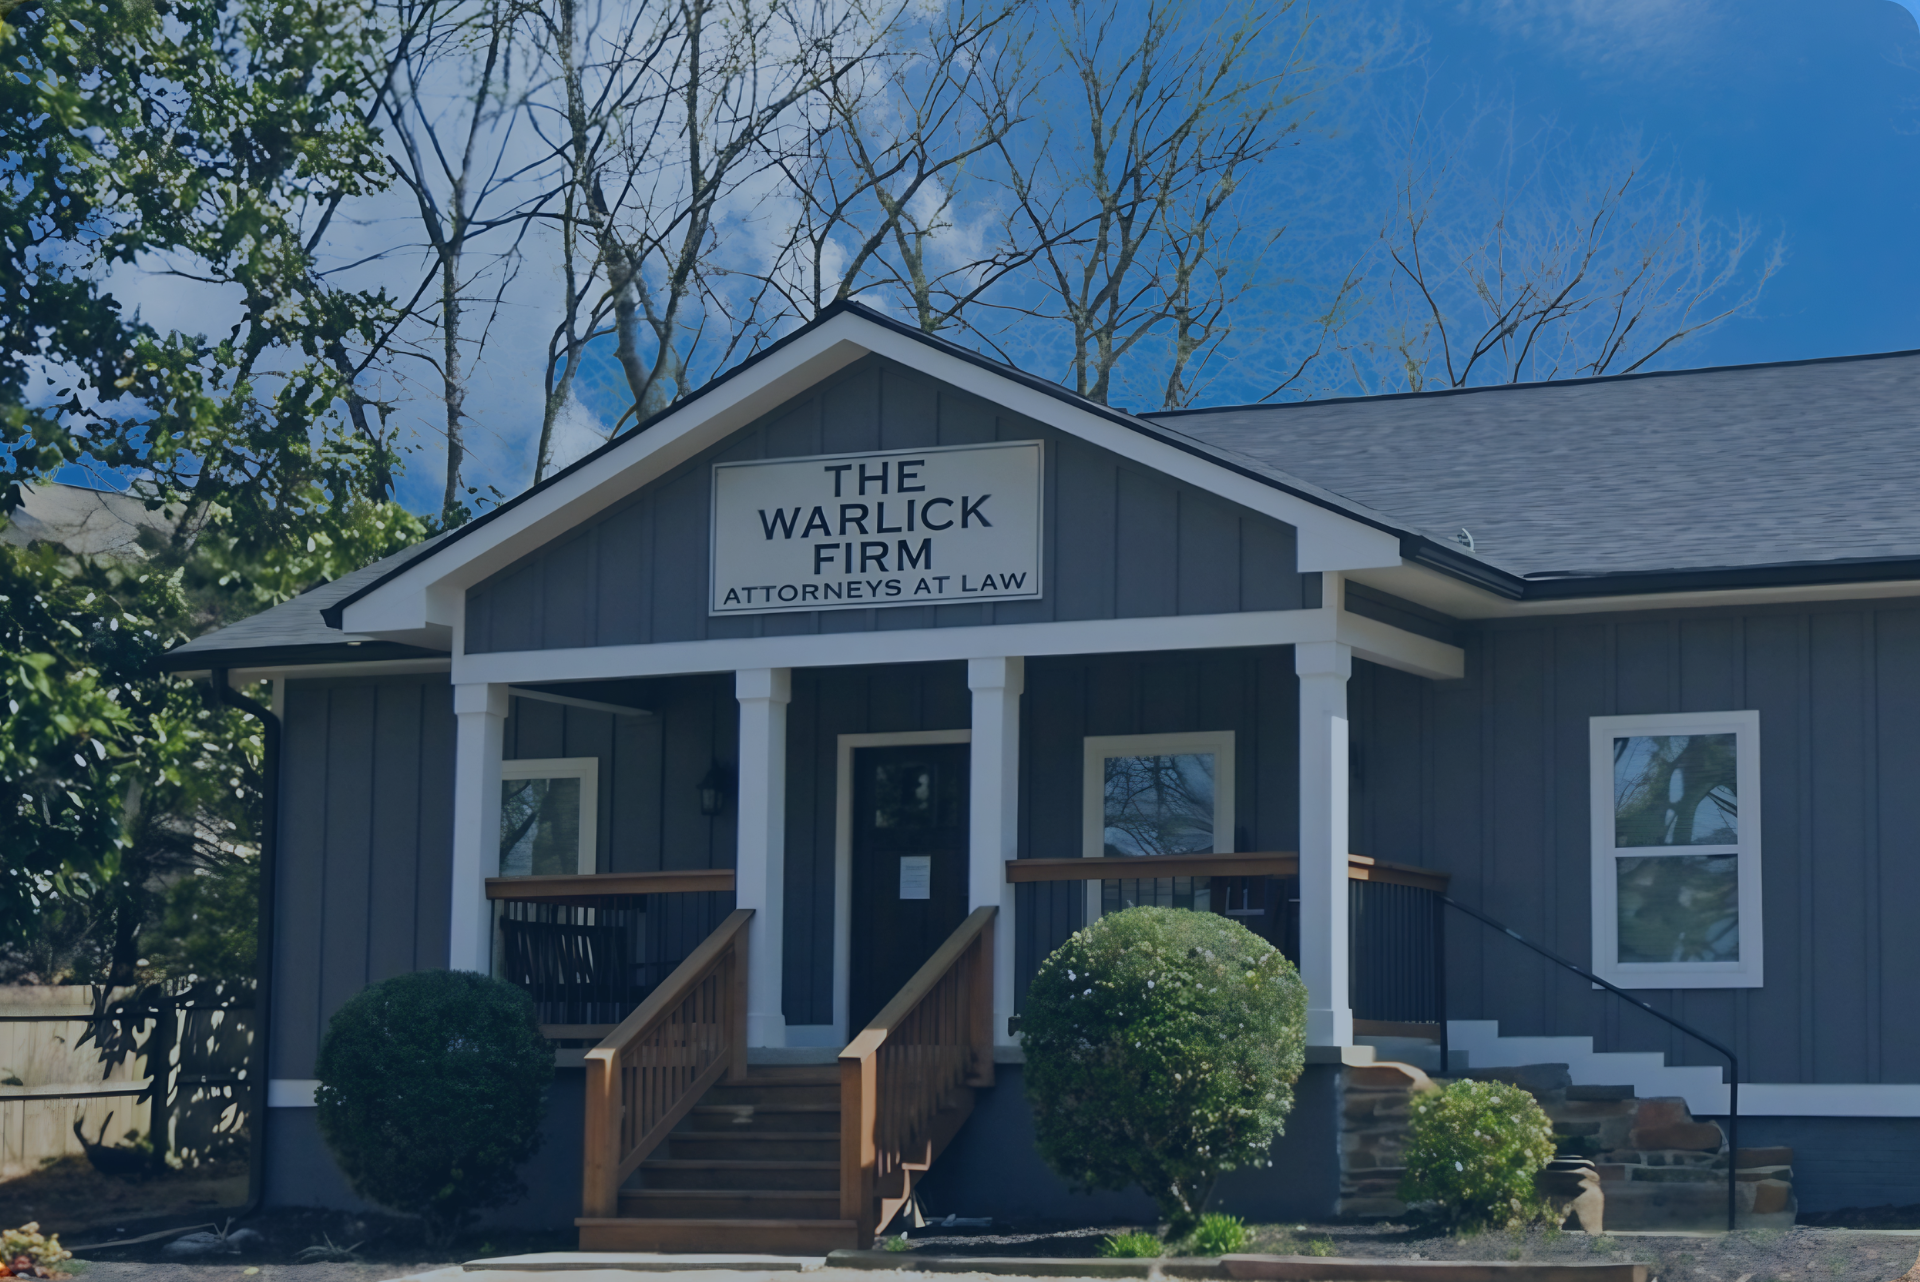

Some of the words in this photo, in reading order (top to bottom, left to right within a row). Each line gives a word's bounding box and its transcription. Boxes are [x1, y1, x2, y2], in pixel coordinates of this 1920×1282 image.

[824, 459, 926, 498] THE
[757, 494, 994, 540] WARLICK
[813, 537, 932, 575] FIRM
[723, 578, 902, 605] ATTORNEYS
[913, 575, 950, 595] AT
[961, 572, 1027, 593] LAW
